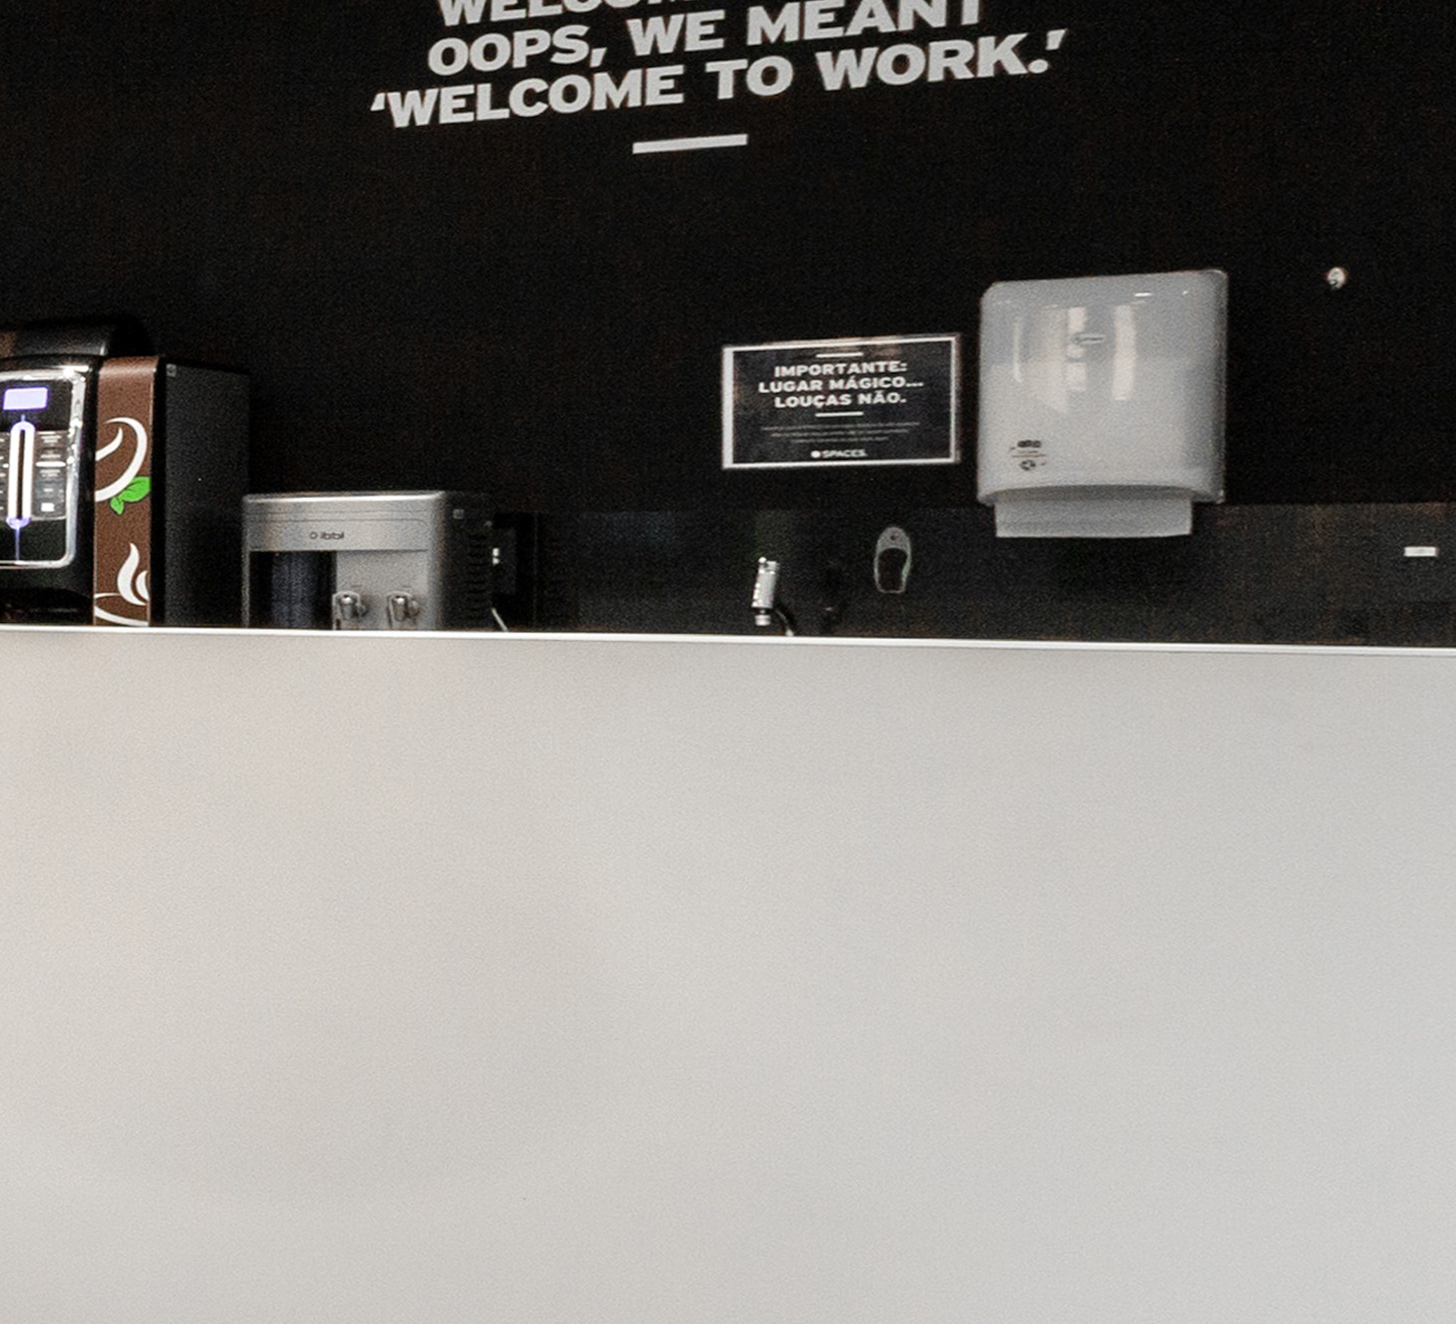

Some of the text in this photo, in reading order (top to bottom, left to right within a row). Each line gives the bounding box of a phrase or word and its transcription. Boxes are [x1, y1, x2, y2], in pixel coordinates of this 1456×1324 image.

[427, 24, 608, 76] OOPS,
[625, 9, 726, 57] WE
[704, 55, 794, 100] TO
[774, 360, 908, 378] IMPORTANTE:
[758, 379, 824, 394] LUGAR
[774, 389, 908, 409] LOUÇAS NÃO.
